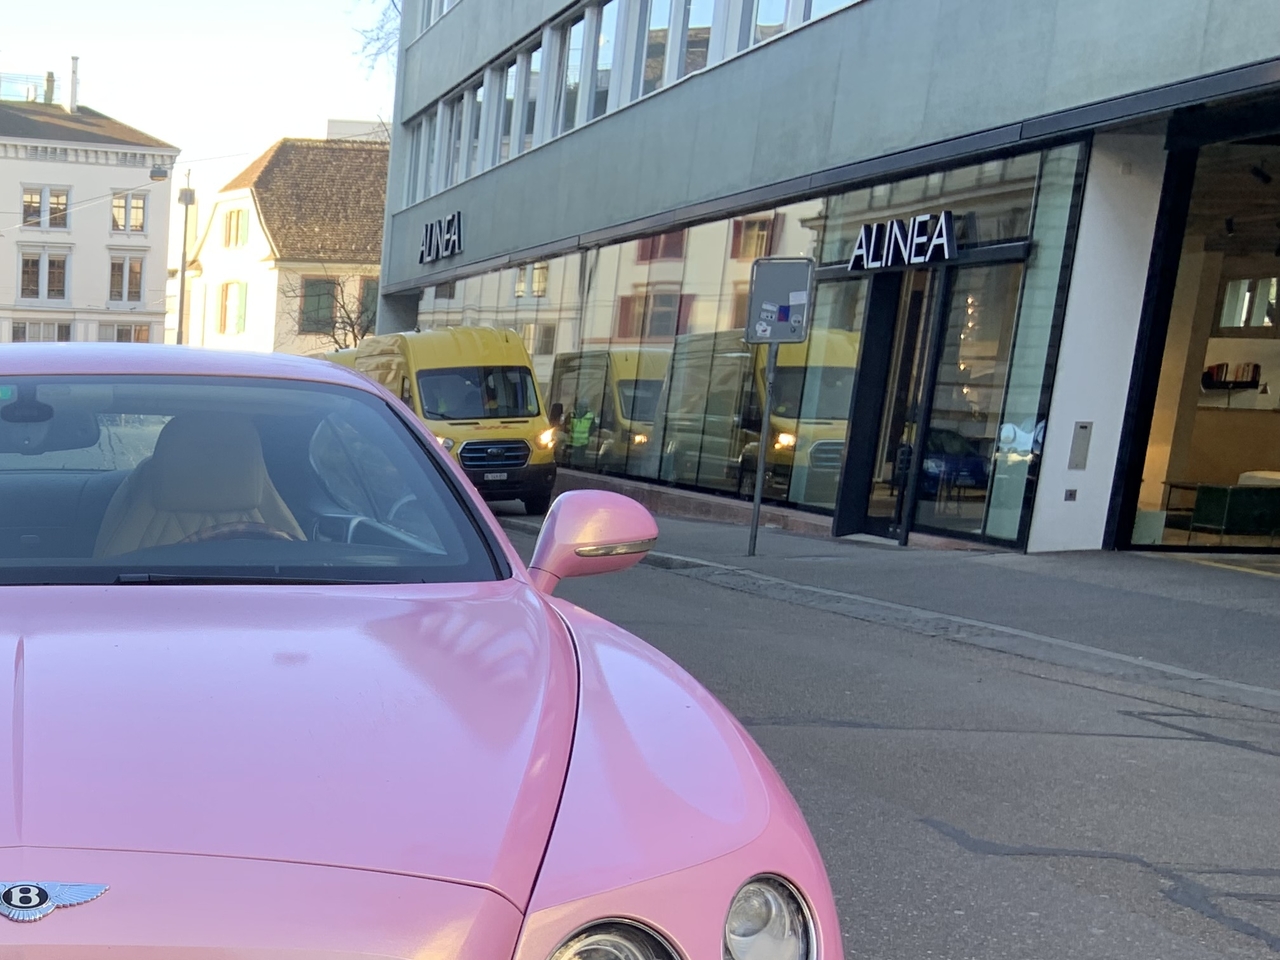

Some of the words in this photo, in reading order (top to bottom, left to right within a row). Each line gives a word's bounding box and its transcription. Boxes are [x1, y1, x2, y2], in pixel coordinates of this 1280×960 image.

[418, 211, 463, 264] ALINEA
[847, 210, 955, 271] ALINEA
[11, 886, 40, 907] B
